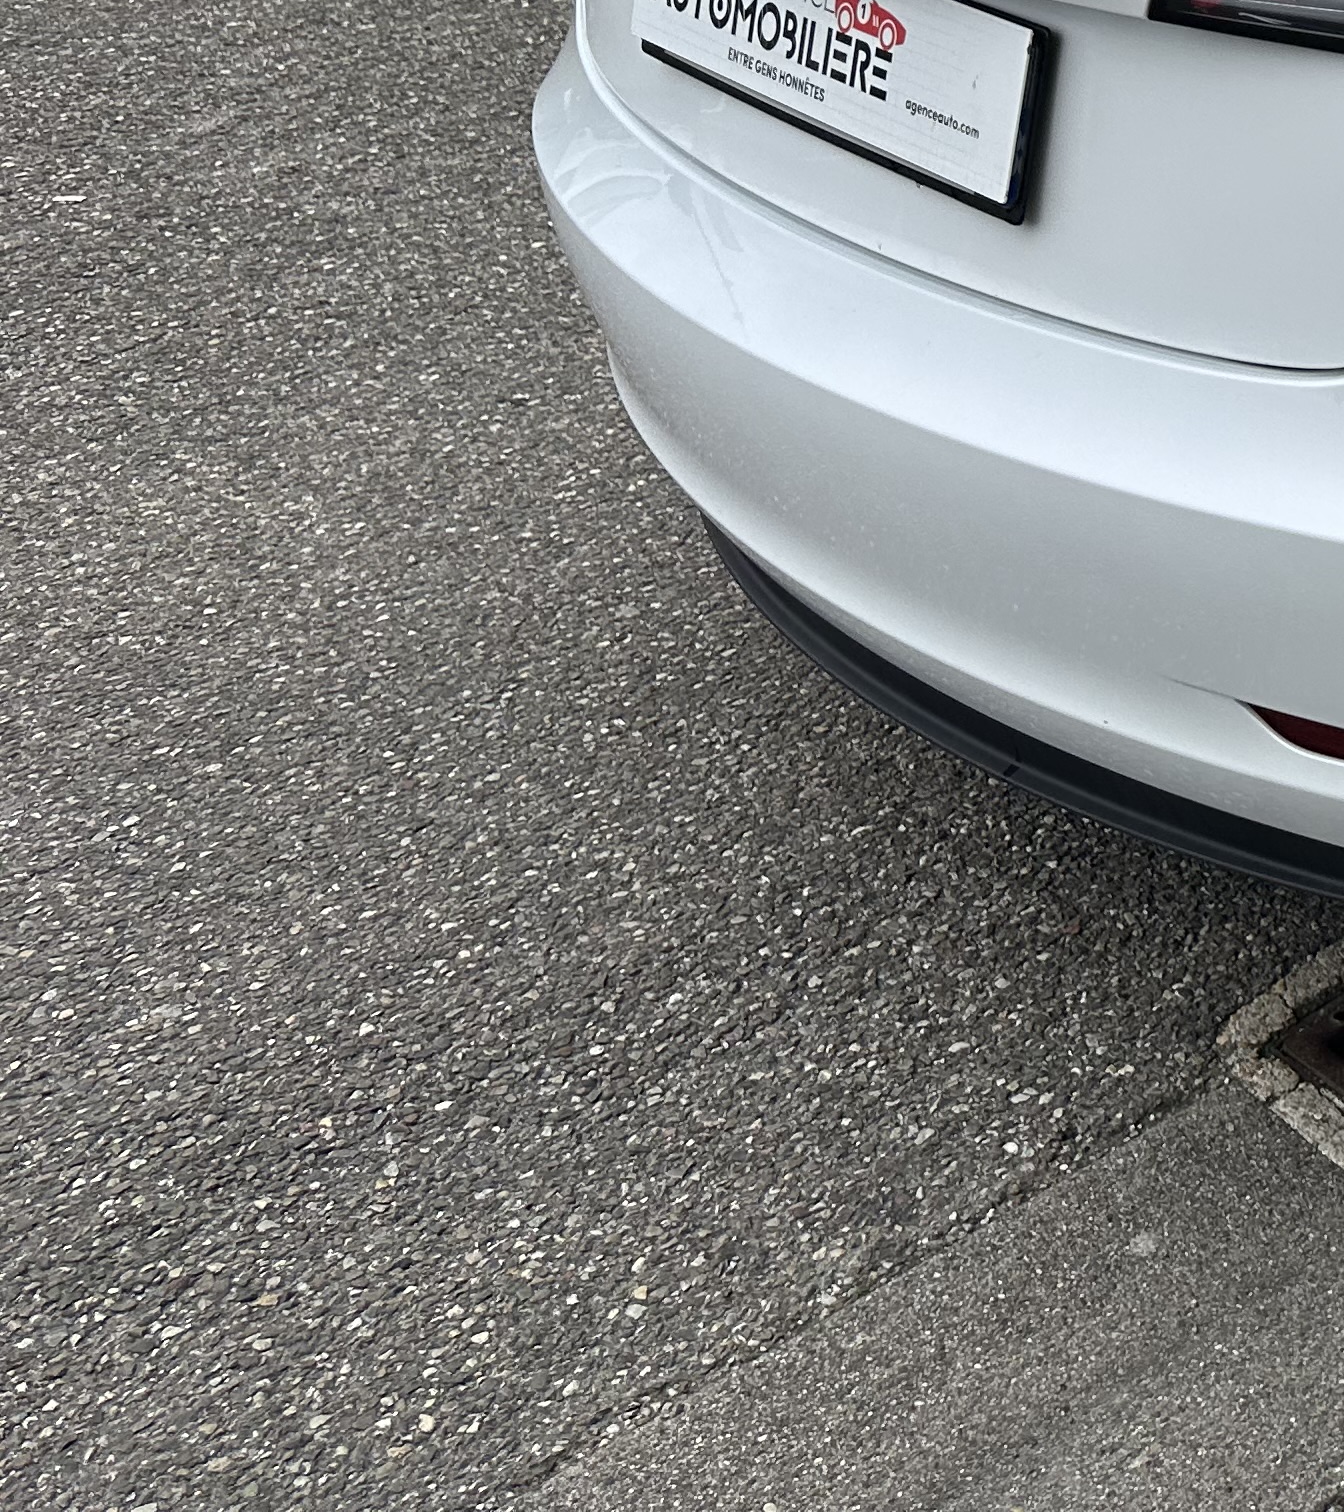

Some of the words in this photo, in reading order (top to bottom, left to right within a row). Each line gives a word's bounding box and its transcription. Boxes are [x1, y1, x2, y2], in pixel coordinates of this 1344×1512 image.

[861, 3, 868, 20] 1
[728, 46, 754, 70] ENTRE
[755, 59, 778, 82] GENS
[779, 70, 825, 102] HONNÊTES
[905, 99, 980, 139] agenceauto.com
